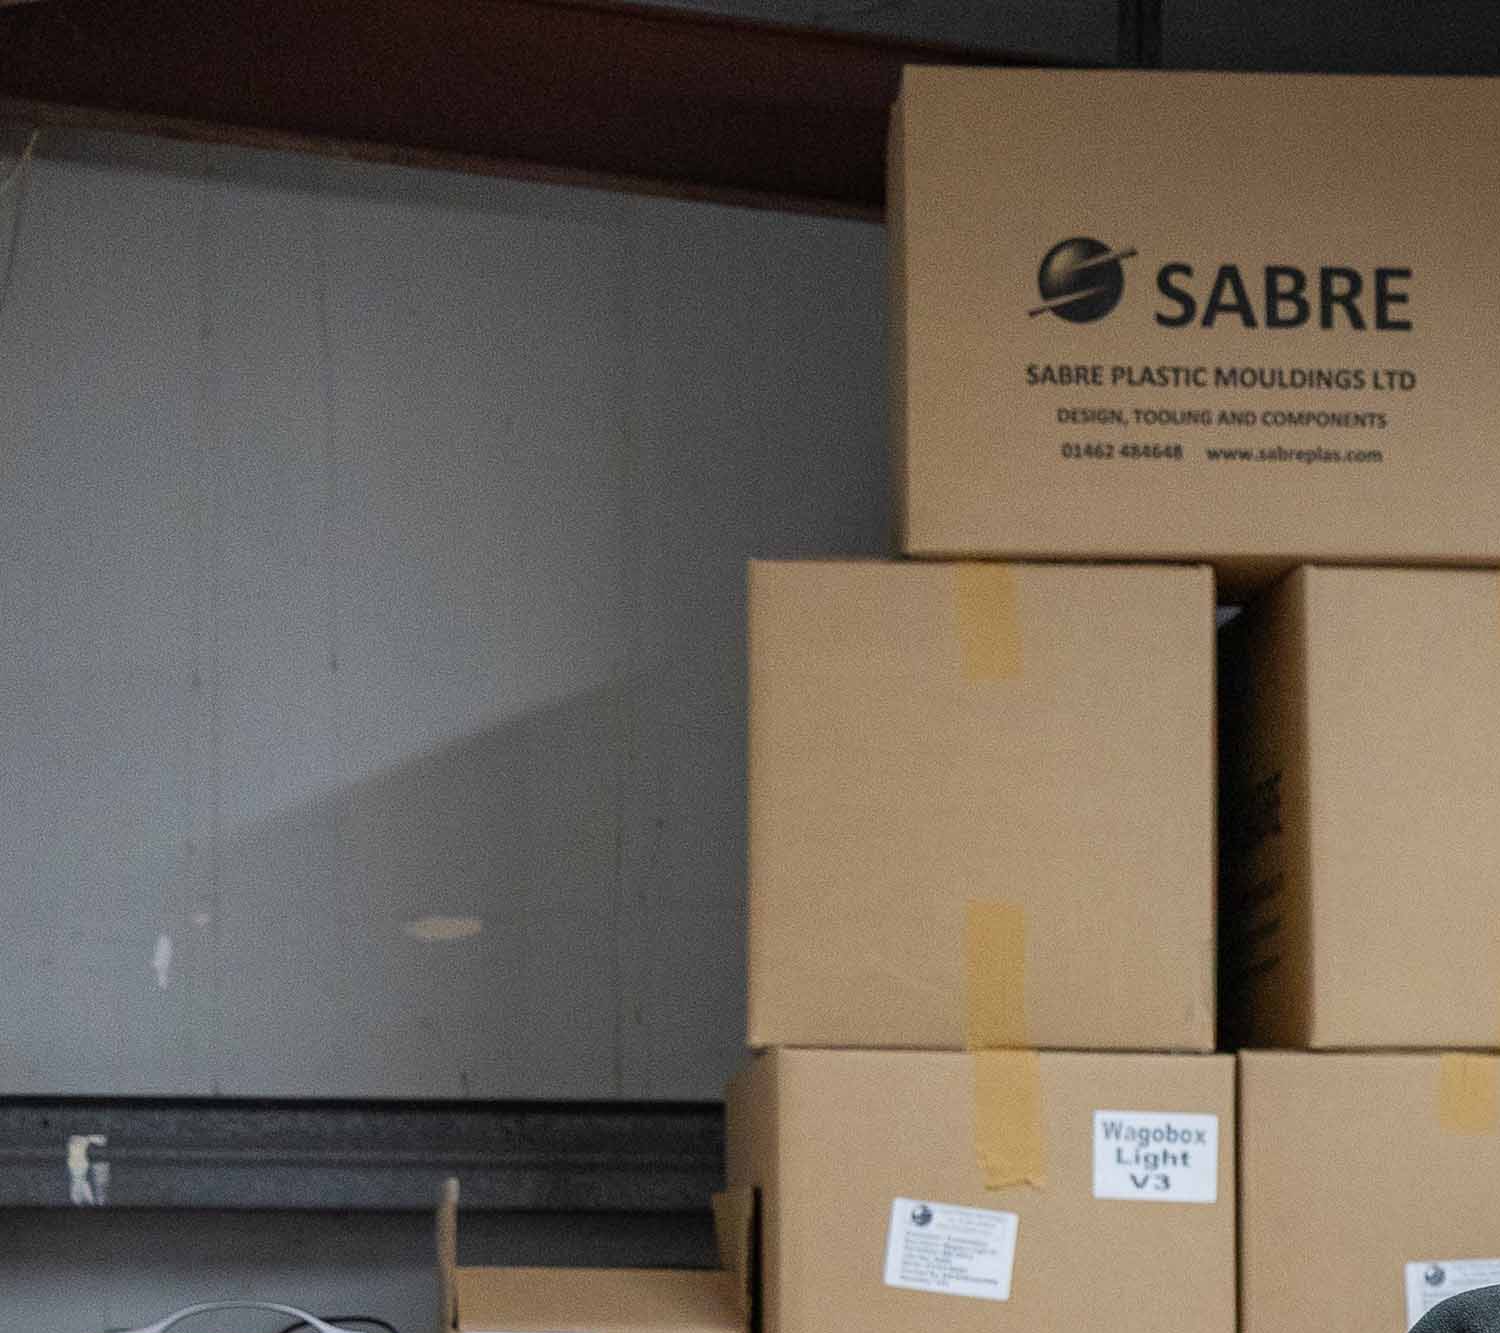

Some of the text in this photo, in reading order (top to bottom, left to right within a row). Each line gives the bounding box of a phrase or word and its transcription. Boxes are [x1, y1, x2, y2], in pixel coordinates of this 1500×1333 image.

[1154, 262, 1413, 331] SABRE
[1025, 364, 1416, 391] SABRE PLASTIC MOULDINGS LTD
[1056, 407, 1388, 430] DESIGN, TOOLING AND COMPONENTS
[1102, 1120, 1208, 1147] Wagobox
[1115, 1146, 1192, 1170] Light
[1129, 1172, 1171, 1191] V3
